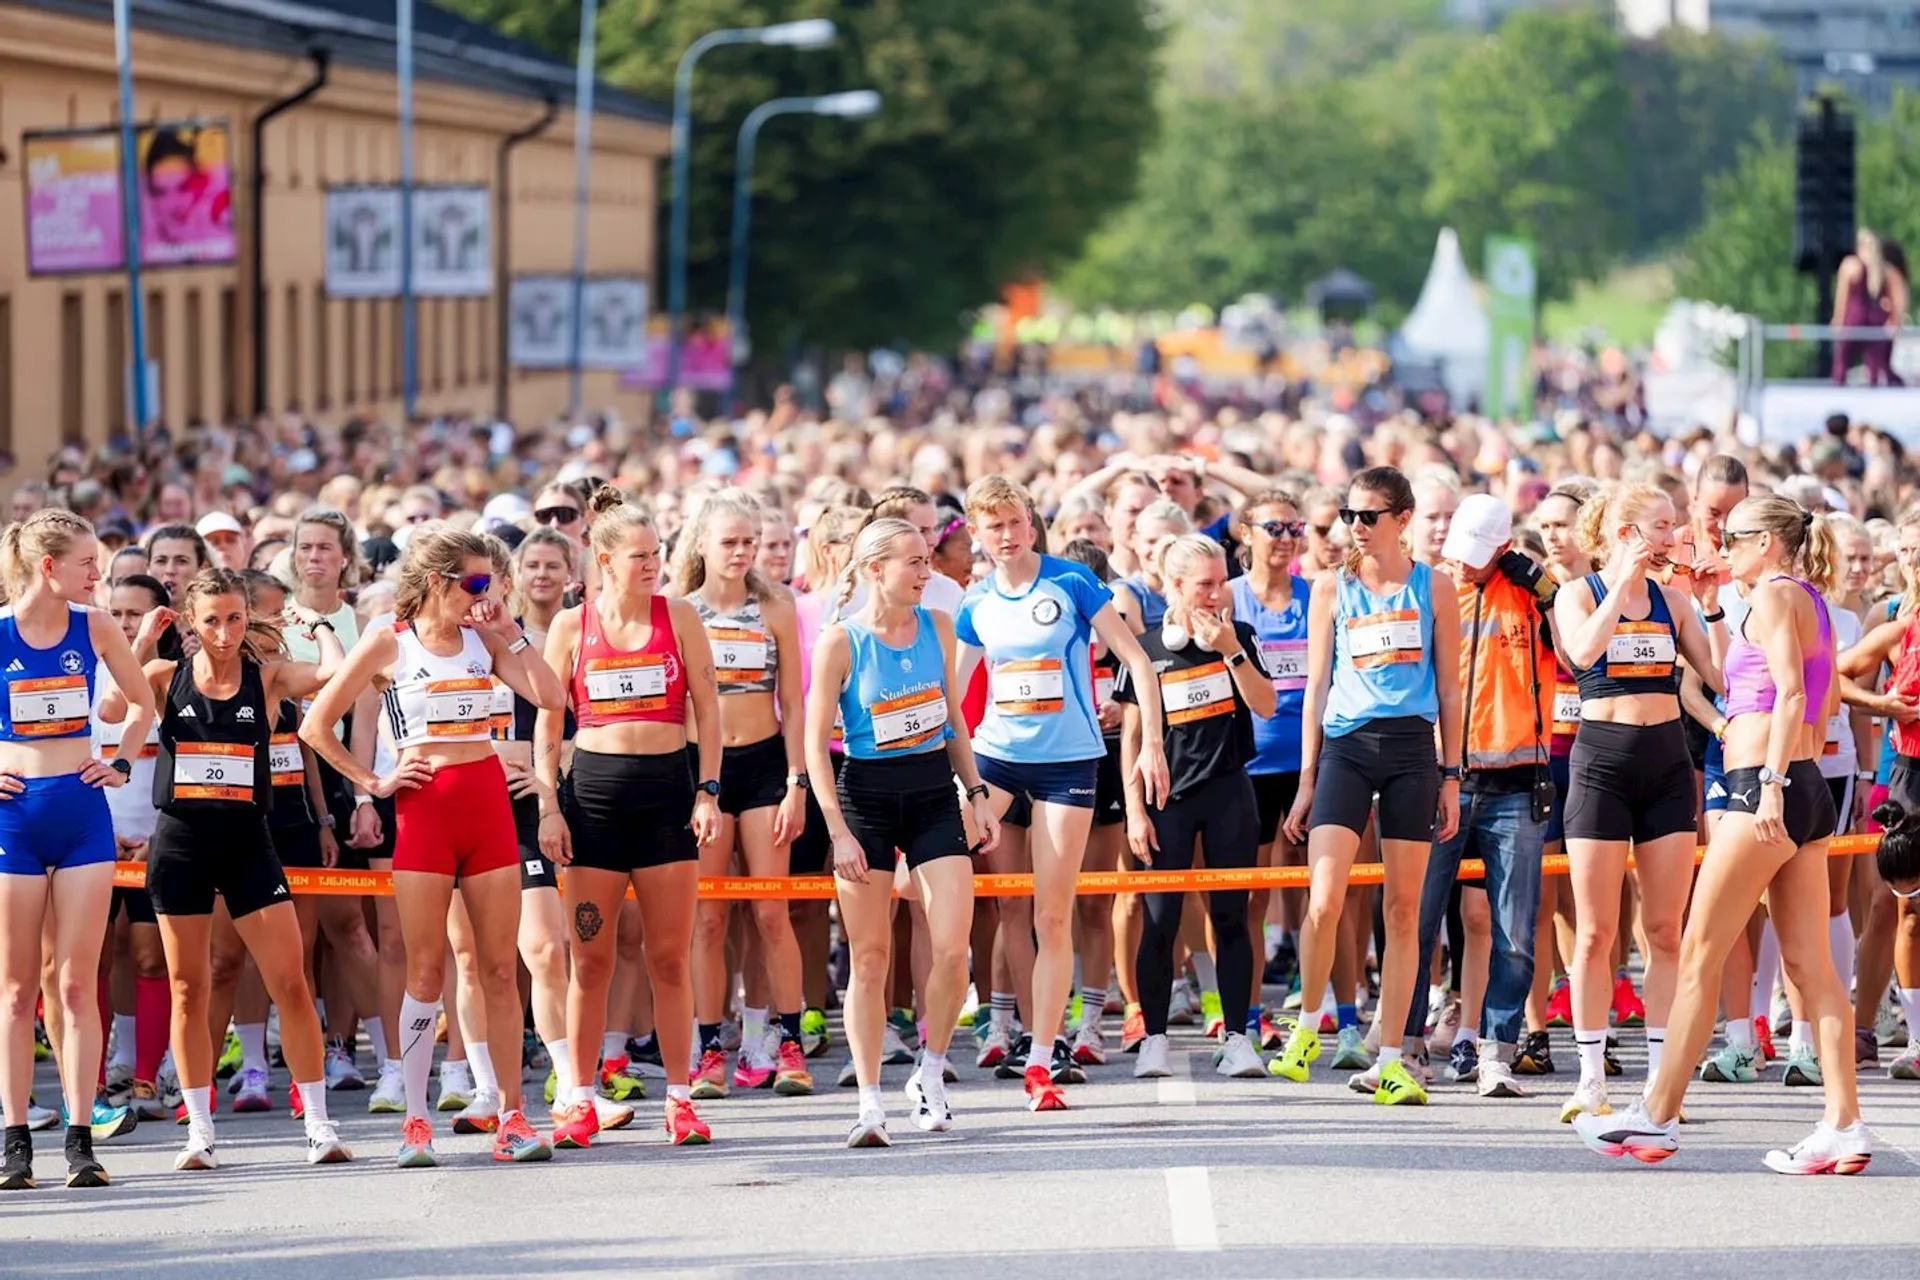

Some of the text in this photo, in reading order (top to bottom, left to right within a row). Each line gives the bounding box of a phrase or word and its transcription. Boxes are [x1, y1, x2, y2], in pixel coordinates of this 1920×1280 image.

[1382, 635, 1391, 646] 11
[723, 653, 736, 664] 19
[1633, 647, 1656, 658] 345
[1276, 663, 1299, 674] 243
[620, 681, 634, 694] 14
[1019, 685, 1032, 697] 13
[1188, 690, 1211, 704] 509
[47, 703, 56, 716] 8
[458, 704, 473, 716] 37
[1561, 707, 1581, 718] 612
[904, 719, 920, 733] 36
[270, 757, 290, 768] 495
[206, 768, 225, 781] 20
[318, 875, 377, 888] TJEJMILEN
[723, 881, 782, 892] TJEJMILEN
